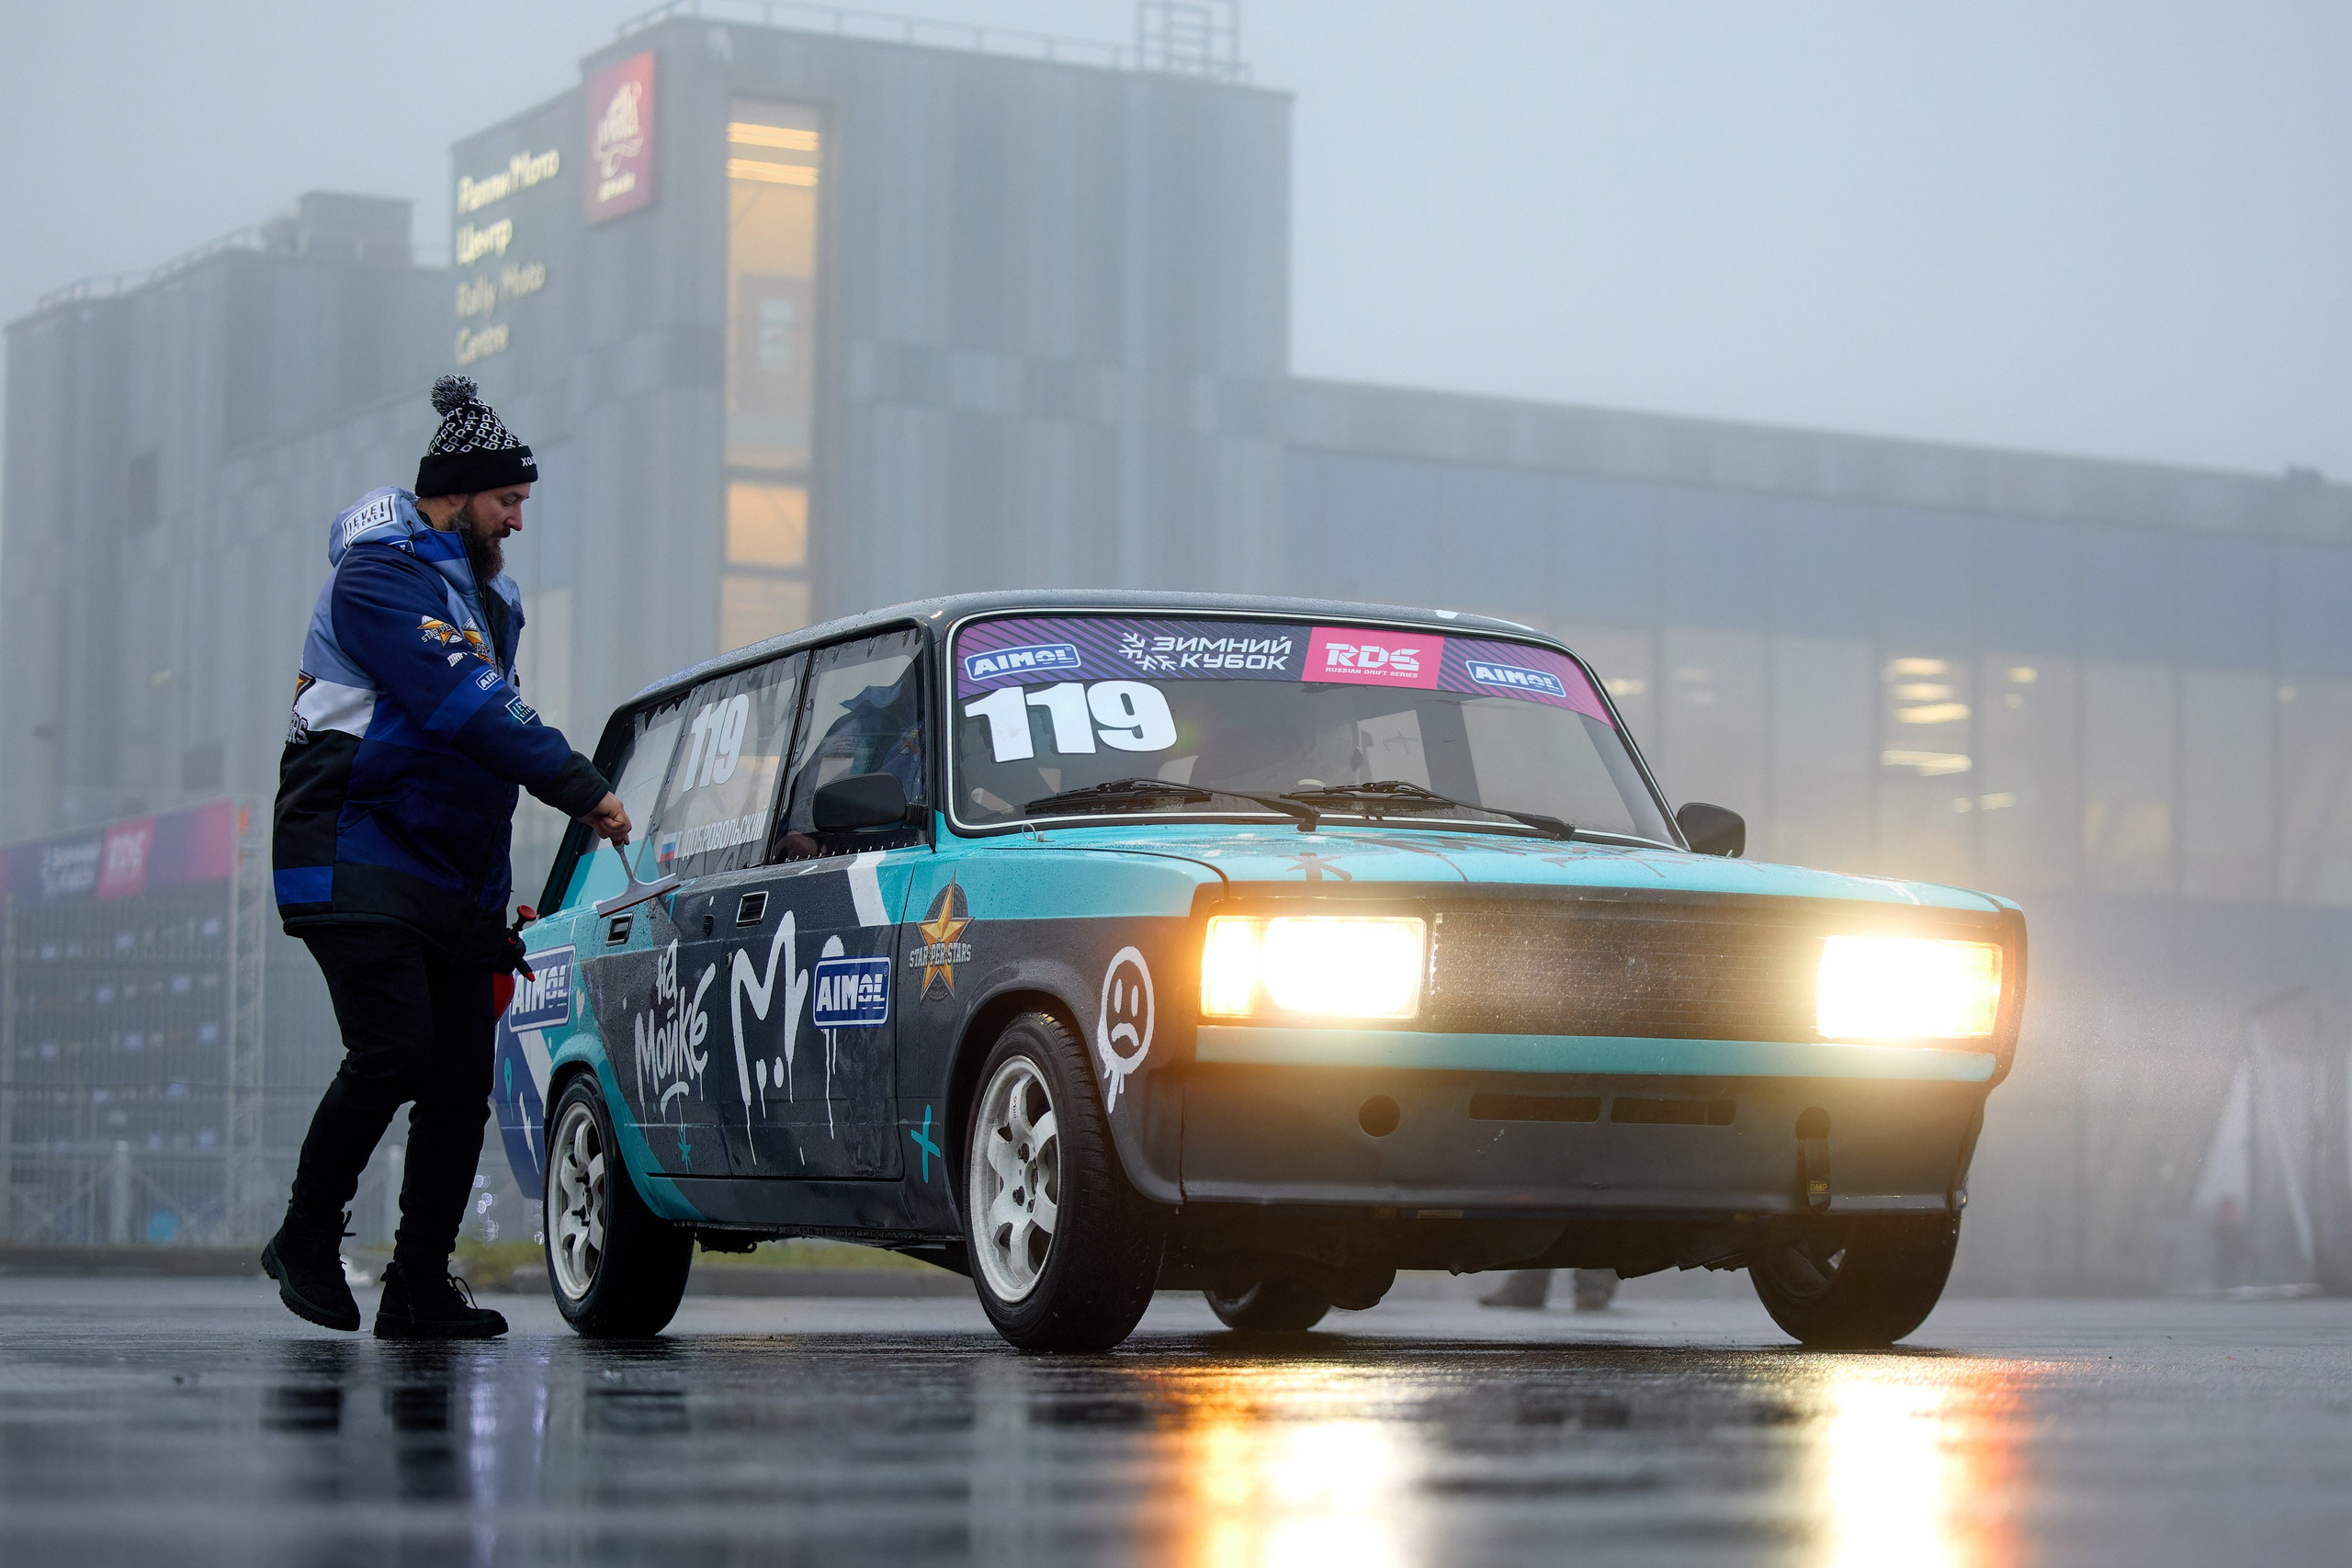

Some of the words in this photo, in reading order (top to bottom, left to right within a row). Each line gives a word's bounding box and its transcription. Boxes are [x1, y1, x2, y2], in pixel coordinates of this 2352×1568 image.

[1150, 637, 1292, 654] ЗИМНИЙ
[1326, 642, 1420, 671] RDS
[974, 649, 1075, 676] AIMOL
[1181, 653, 1289, 671] КУБОК
[1476, 666, 1562, 694] AIMOL
[964, 681, 1177, 762] 119
[683, 694, 750, 793] 119
[909, 945, 929, 967] STAR
[930, 942, 946, 966] PER
[947, 942, 972, 964] STARS
[511, 964, 569, 1016] AIMOL
[816, 974, 886, 1011] AIMOL
